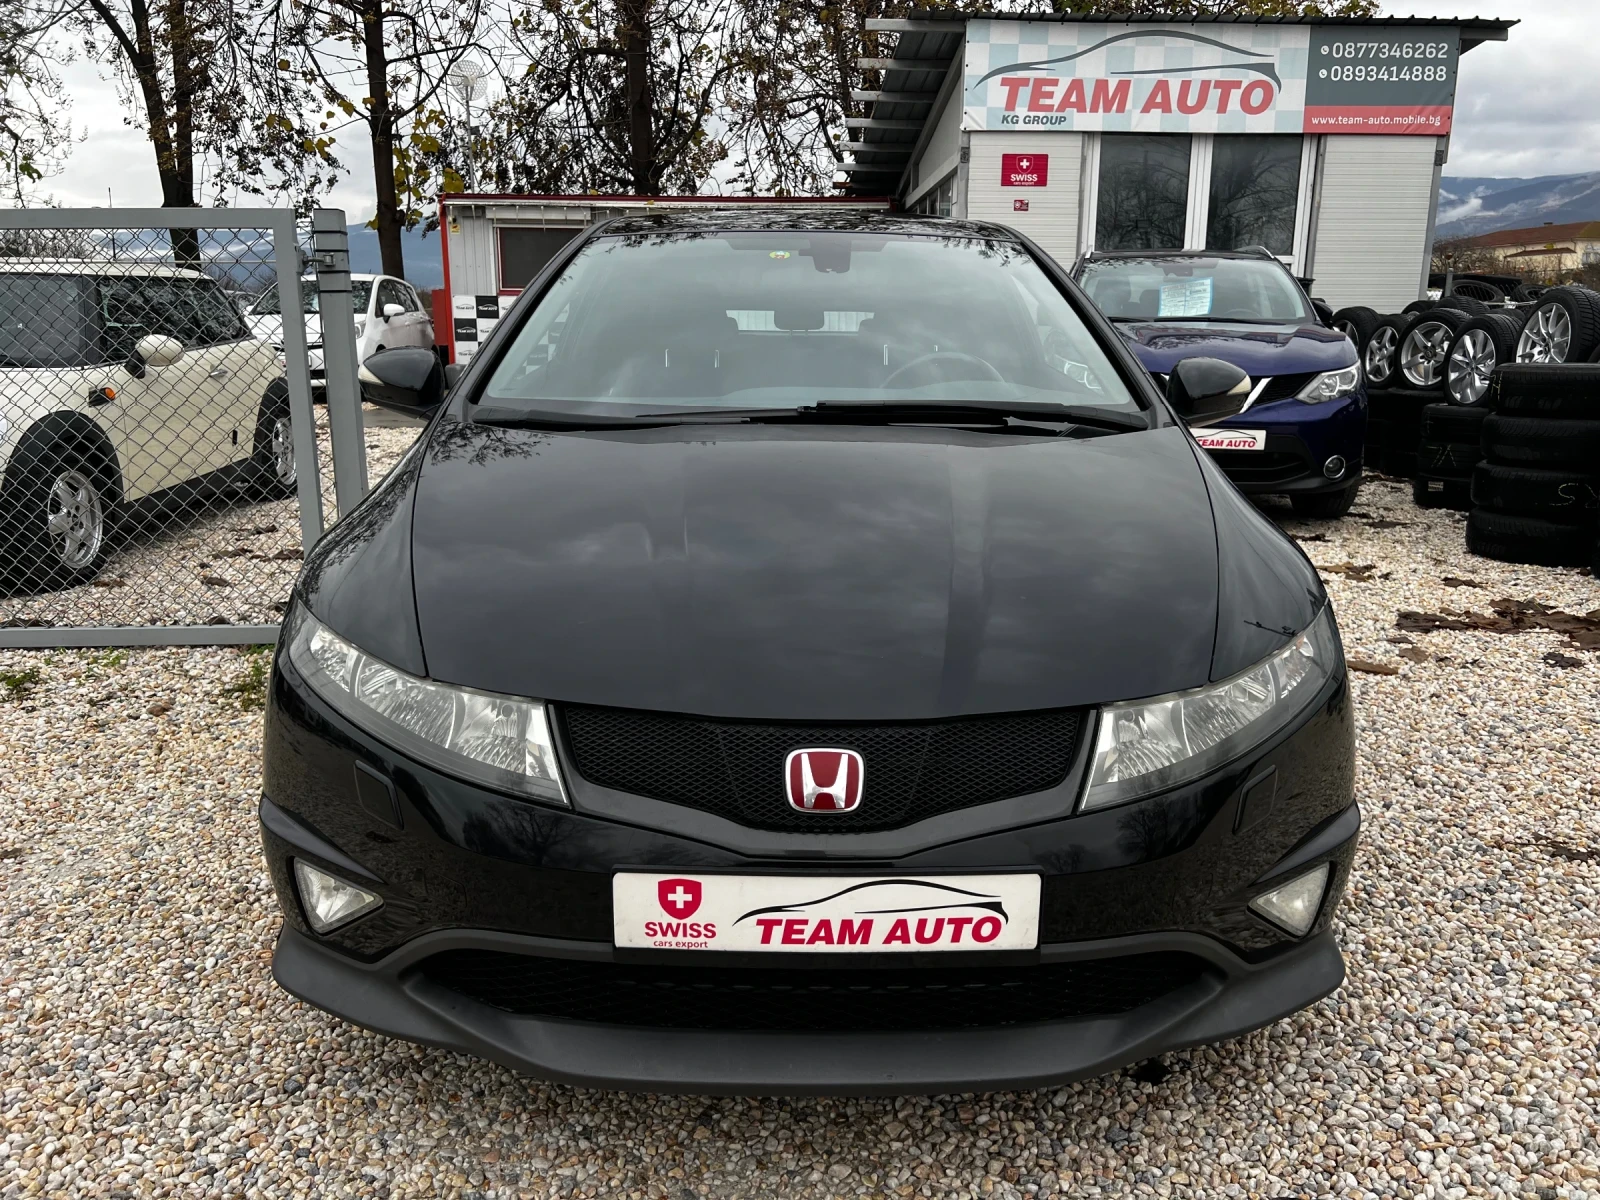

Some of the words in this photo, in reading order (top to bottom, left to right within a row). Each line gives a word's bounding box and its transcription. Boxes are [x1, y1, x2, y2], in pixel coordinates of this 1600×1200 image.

[1332, 42, 1449, 59] 0877346262
[1330, 65, 1447, 81] 0893414888
[1000, 77, 1132, 113] TEAM
[1140, 79, 1274, 115] AUTO
[1001, 115, 1019, 125] KG
[1022, 116, 1067, 126] GROUP
[1311, 115, 1441, 126] www.team-auto.mobile.bg
[1010, 174, 1038, 182] SWISS
[1225, 440, 1256, 448] AUTO
[644, 921, 717, 939] SWISS
[755, 918, 873, 945] TEAM
[882, 917, 1002, 945] AUTO
[675, 941, 709, 949] export
